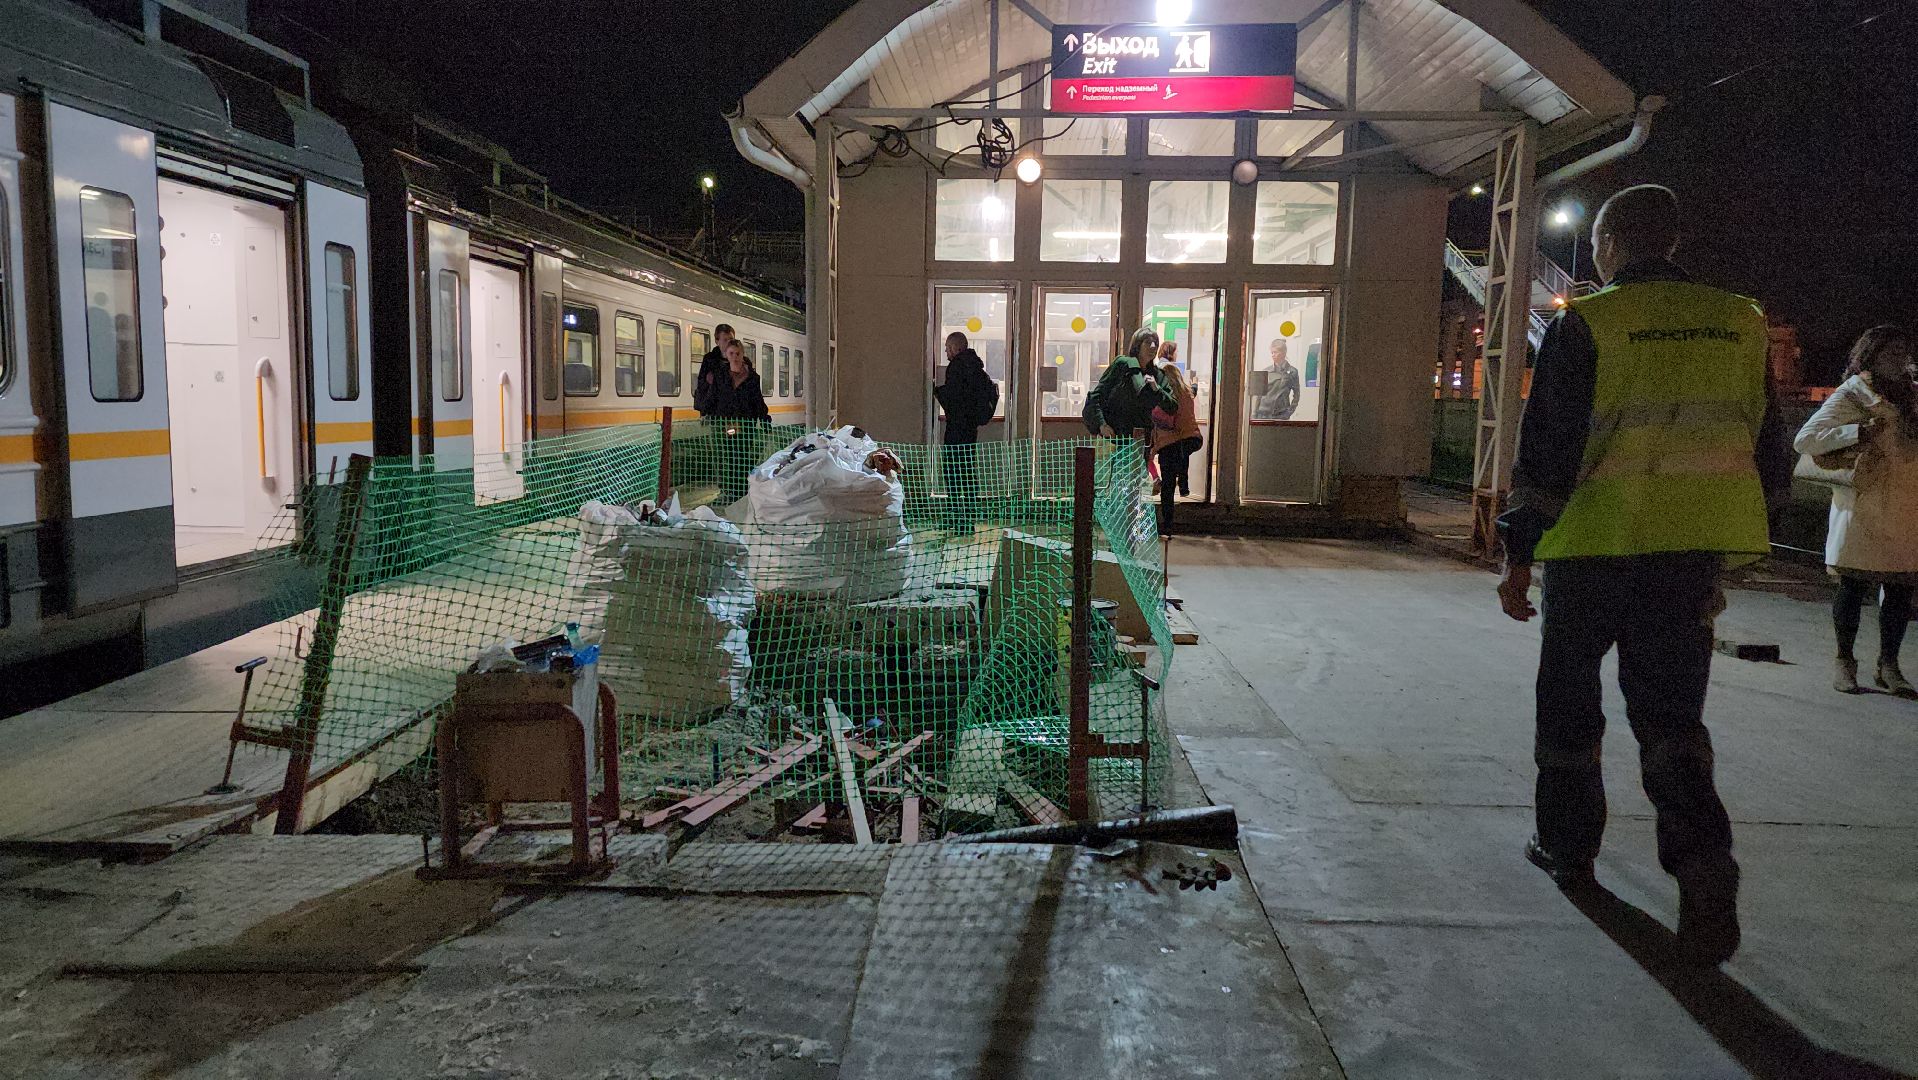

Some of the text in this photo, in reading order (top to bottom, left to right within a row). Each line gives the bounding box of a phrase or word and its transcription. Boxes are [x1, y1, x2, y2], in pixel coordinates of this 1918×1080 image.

[1082, 32, 1159, 58] Выход
[1082, 57, 1117, 74] Exit
[1082, 83, 1158, 94] Переход надземный
